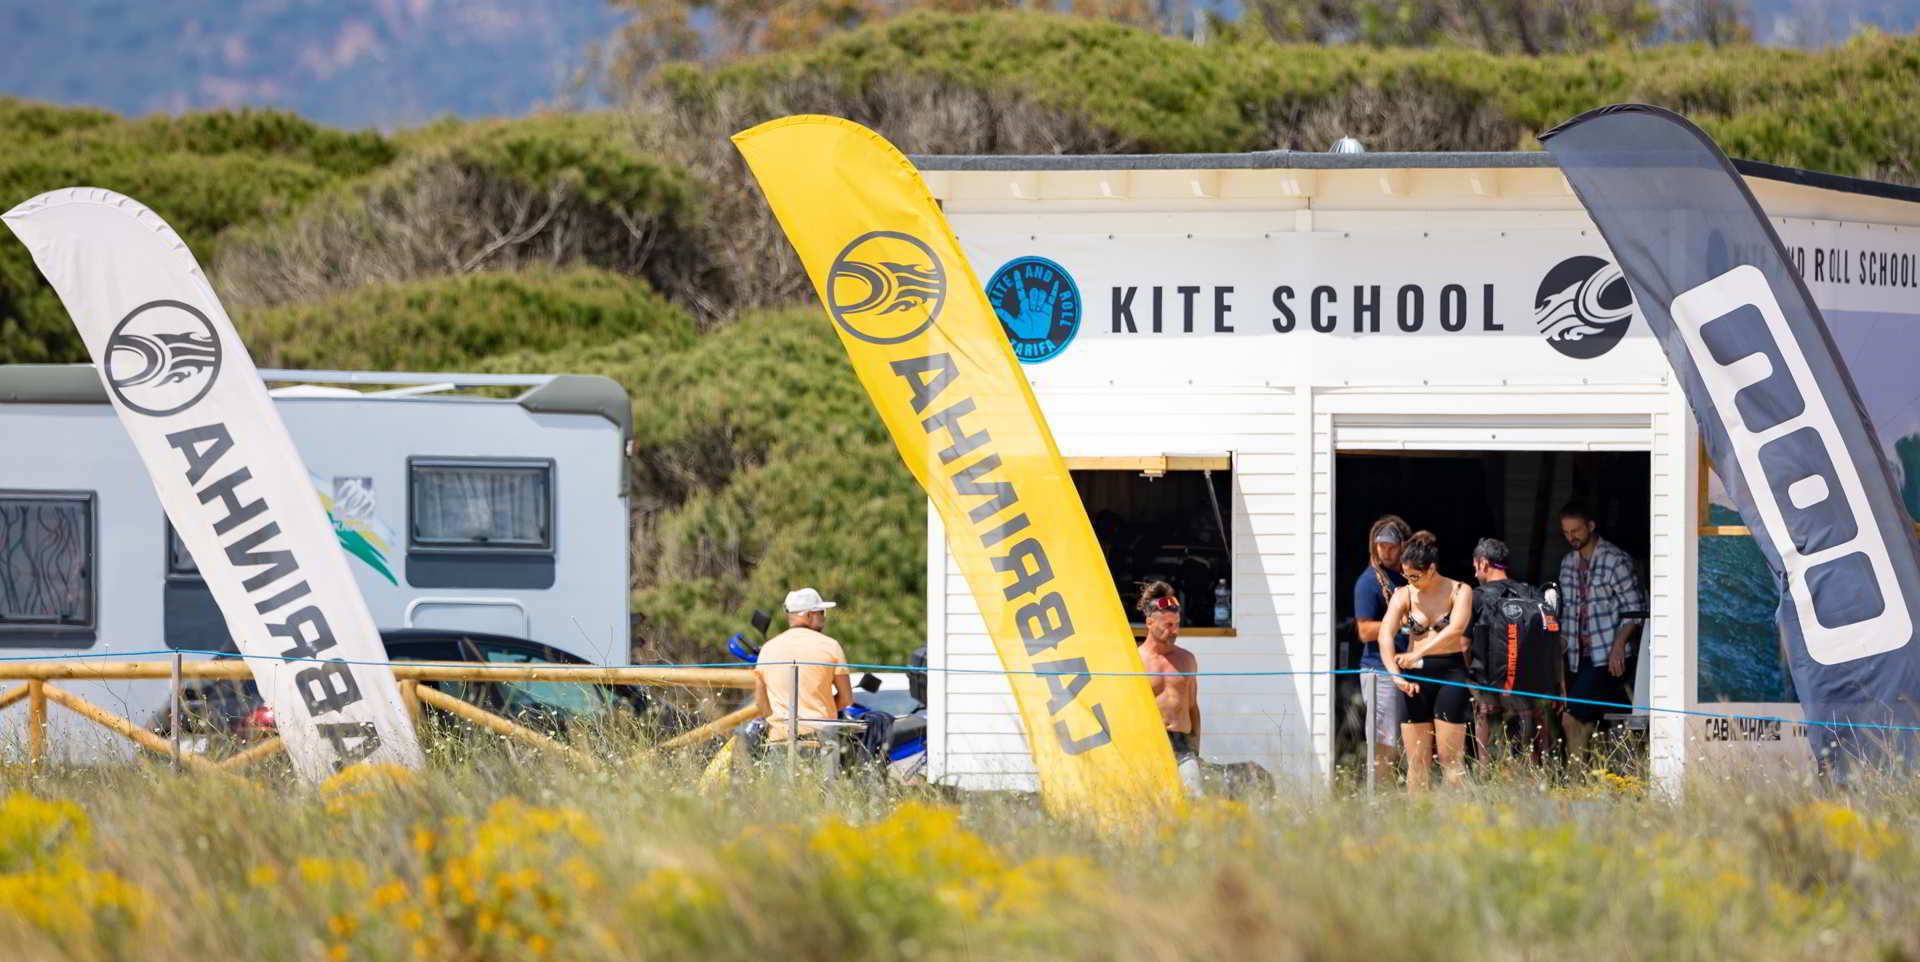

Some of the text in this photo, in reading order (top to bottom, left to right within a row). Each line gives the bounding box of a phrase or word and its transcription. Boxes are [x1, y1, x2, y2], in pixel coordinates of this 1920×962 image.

[1815, 248, 1851, 284] ROLL
[1860, 250, 1918, 288] SCHOOL
[1024, 264, 1053, 282] AND
[1059, 290, 1074, 327] ROLL
[1111, 283, 1504, 333] KITE SCHOOL
